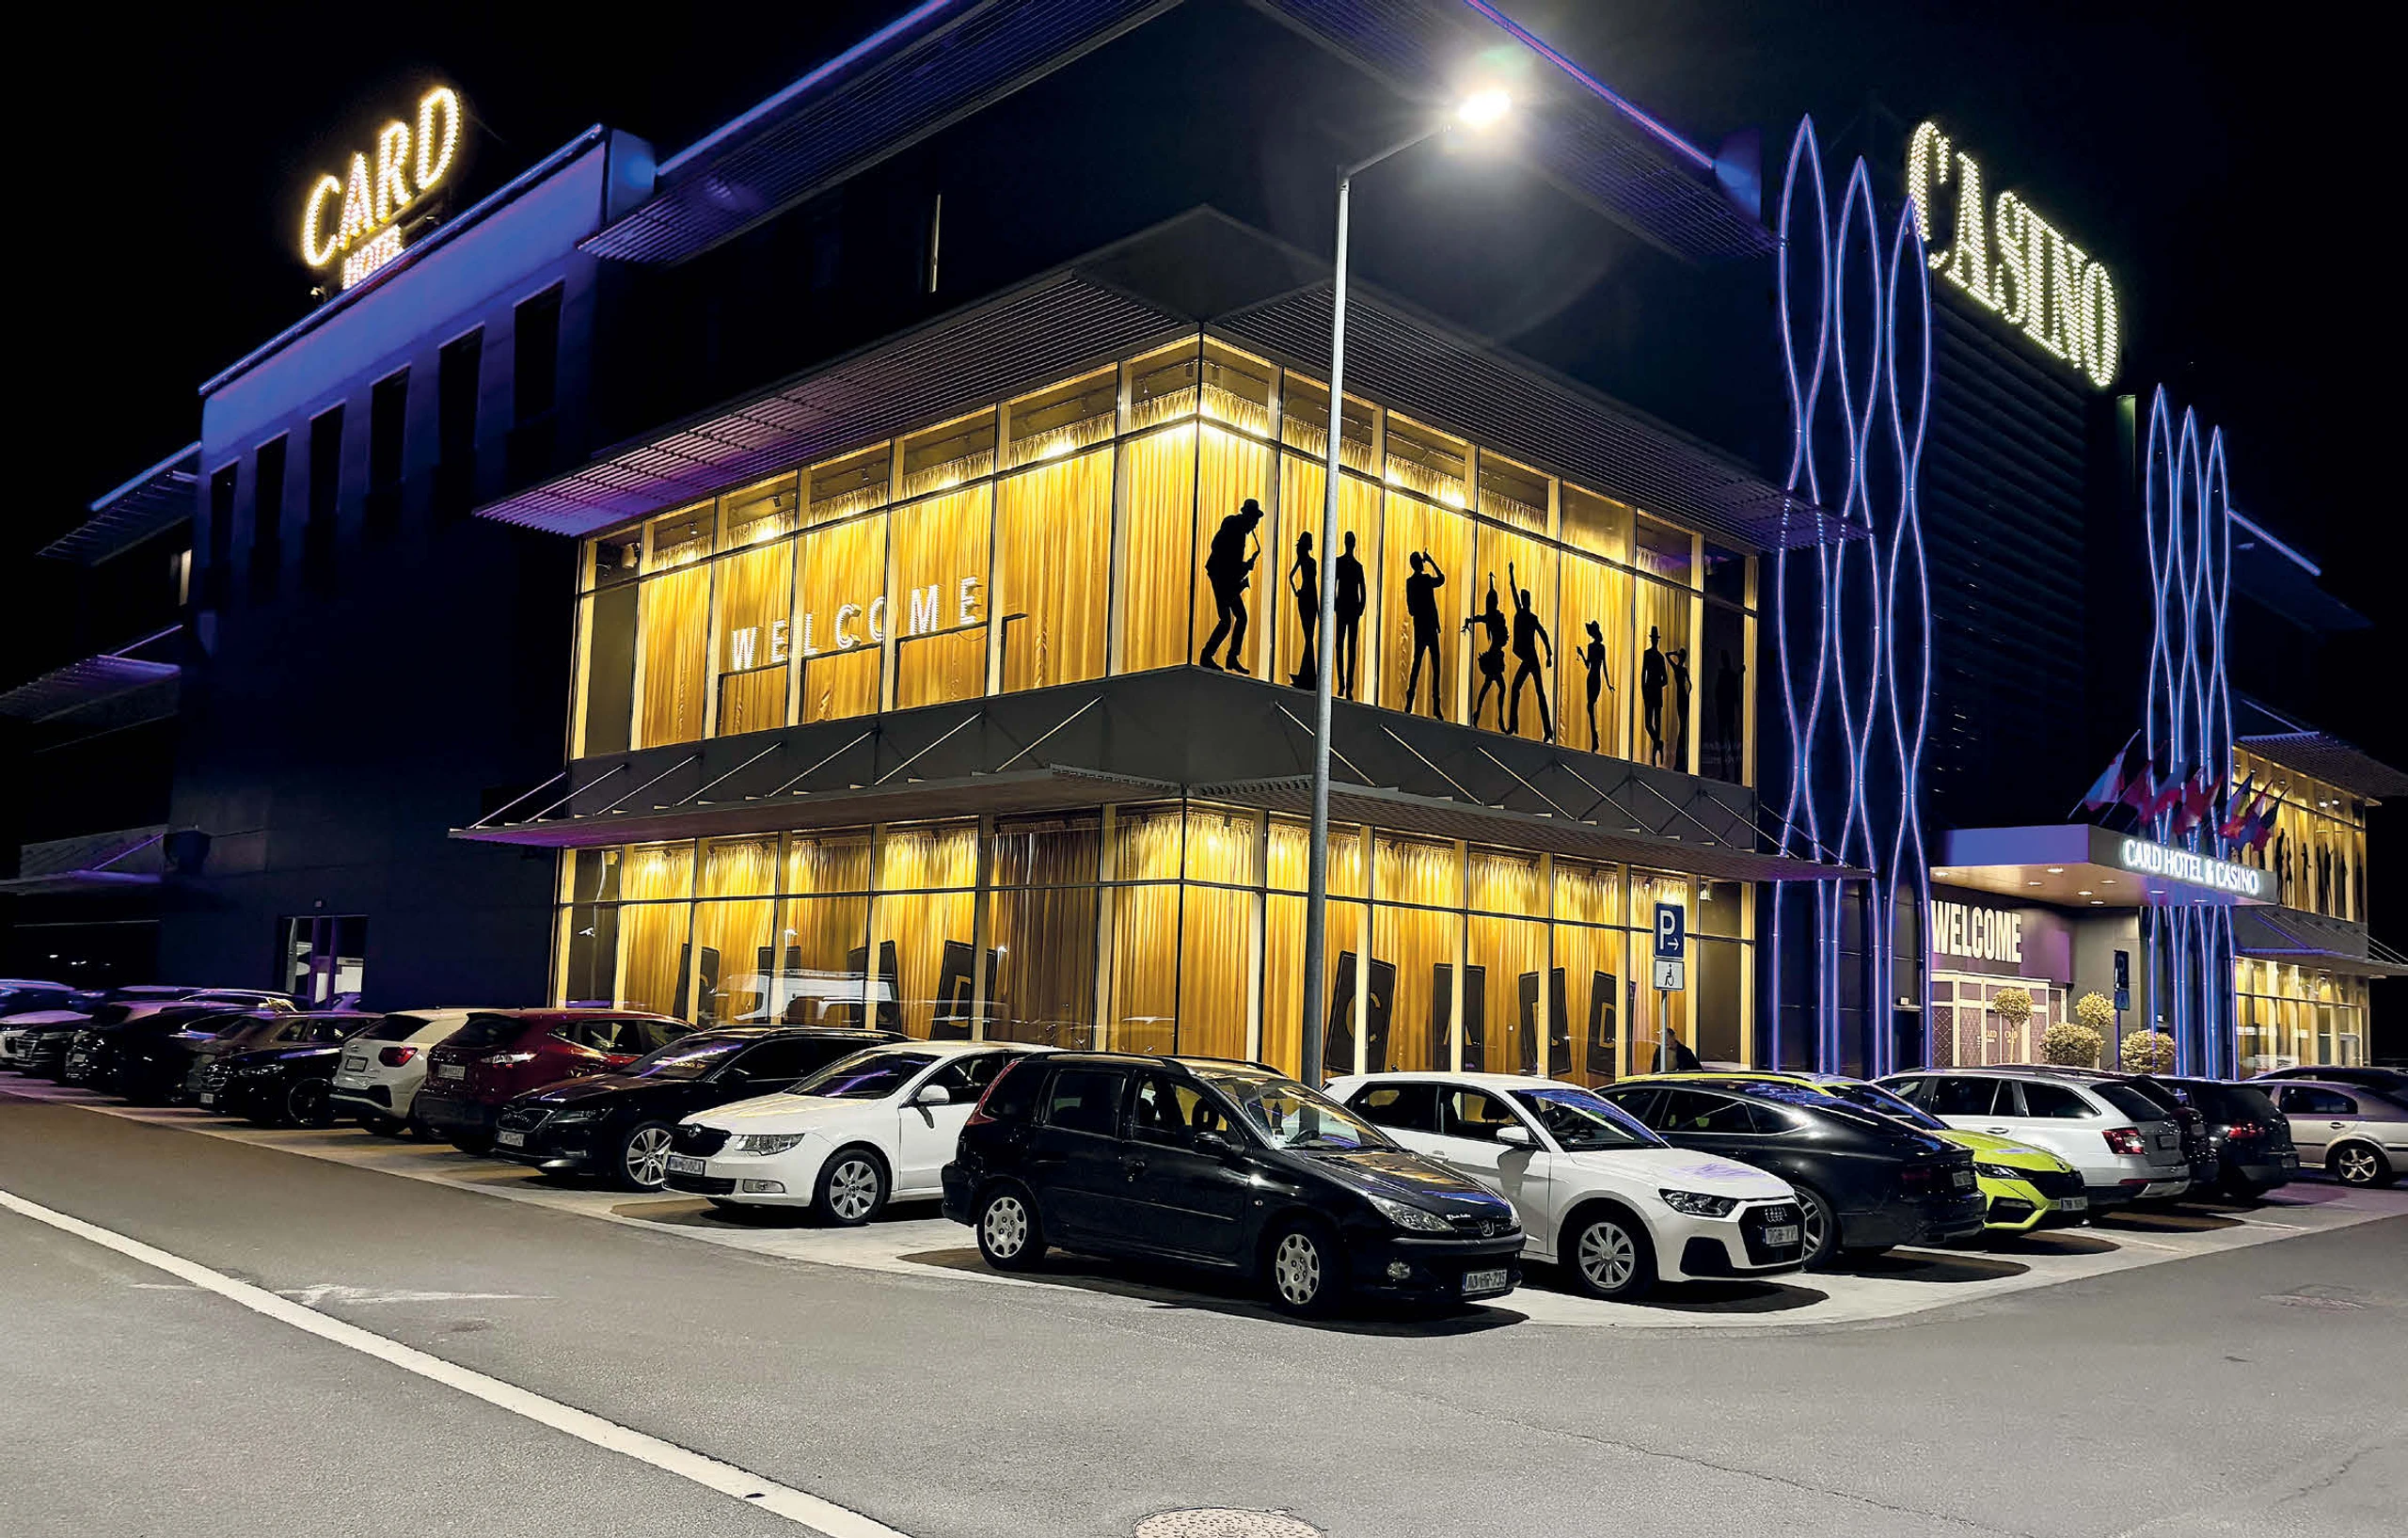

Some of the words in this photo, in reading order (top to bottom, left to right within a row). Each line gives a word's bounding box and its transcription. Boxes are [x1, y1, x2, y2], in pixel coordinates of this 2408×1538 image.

[303, 87, 459, 266] CARD
[1909, 121, 2117, 387] CASINO
[731, 576, 981, 671] WELCOME
[2125, 839, 2162, 872] CARD
[2164, 848, 2204, 881] HOTEL
[2205, 858, 2214, 886] &
[2215, 862, 2259, 896] CASINO
[1659, 910, 1675, 950] P
[1930, 899, 2022, 963] WELCOME
